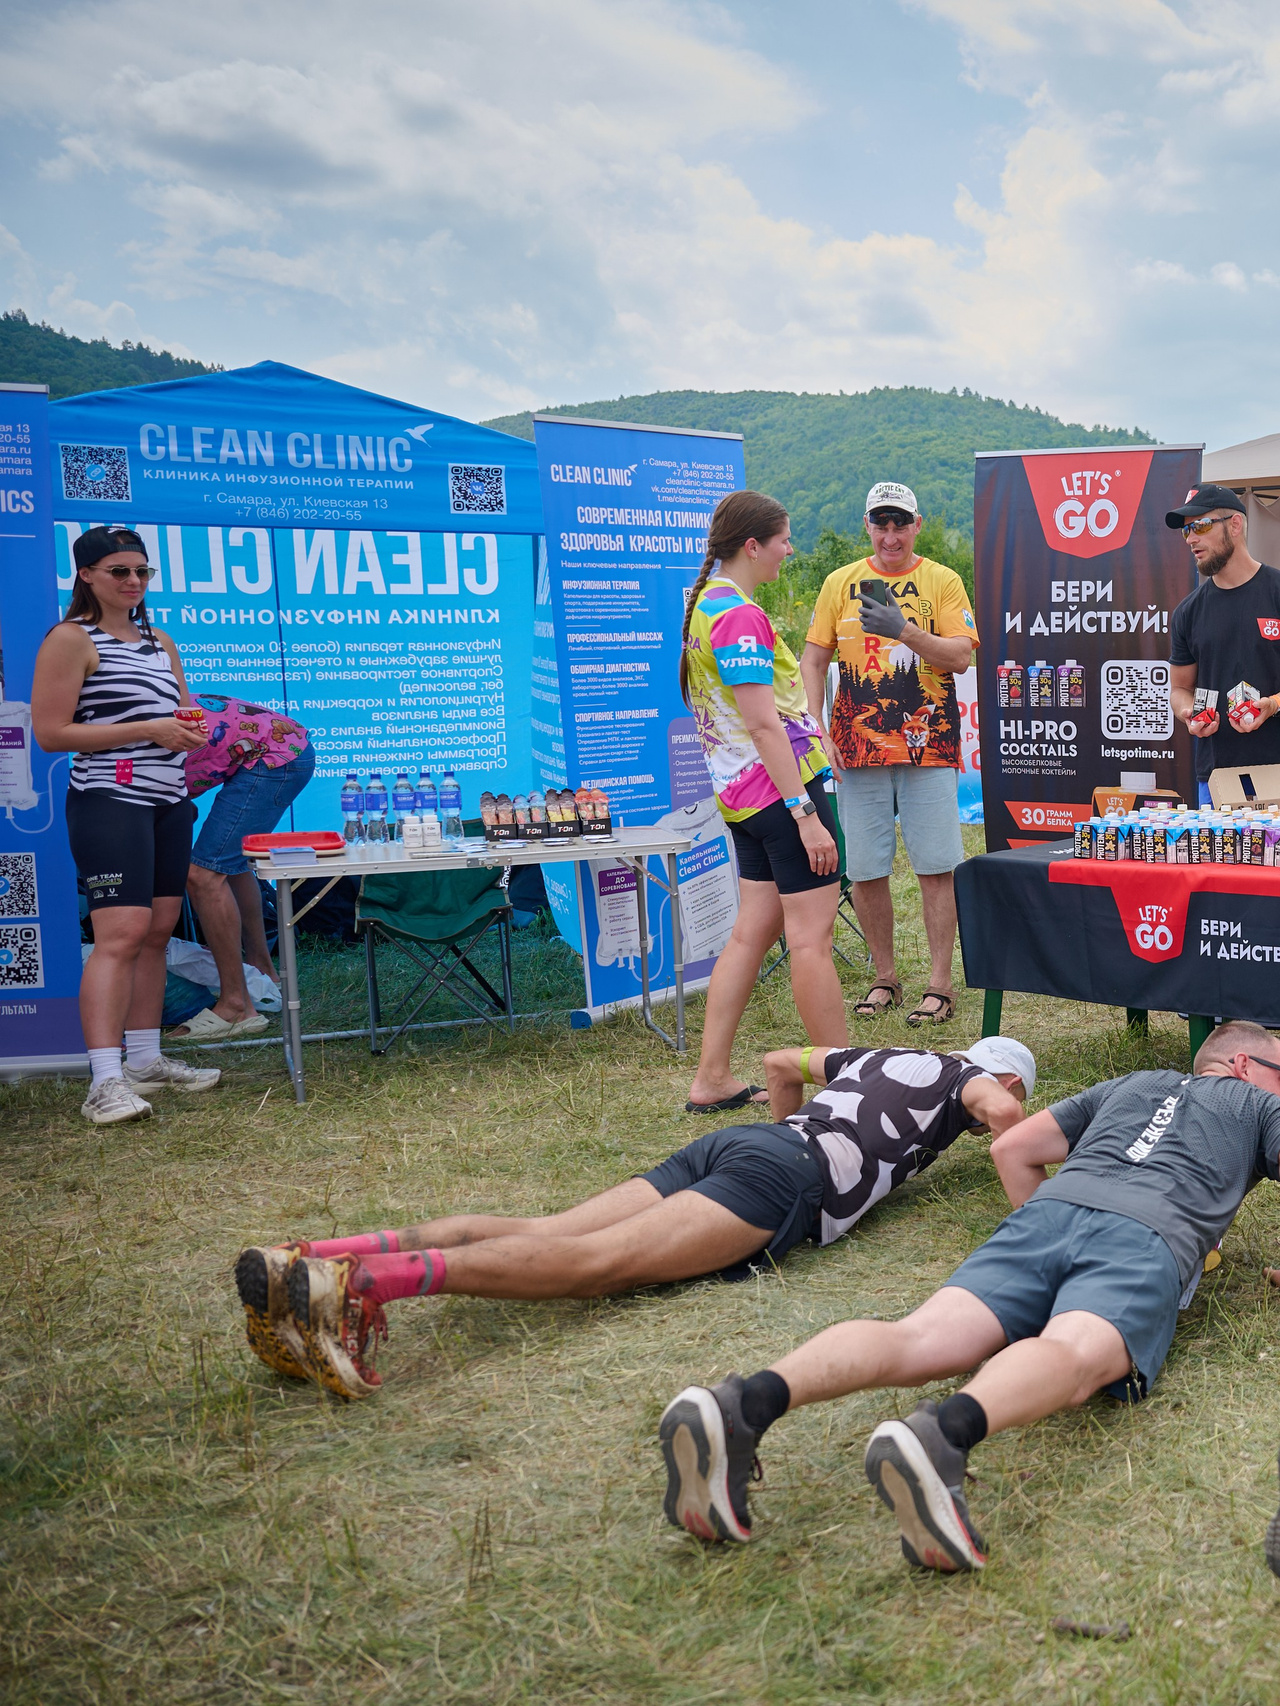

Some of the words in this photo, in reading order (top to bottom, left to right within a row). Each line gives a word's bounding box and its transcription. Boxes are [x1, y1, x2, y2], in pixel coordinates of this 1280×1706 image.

[139, 423, 275, 467] CLEAN
[286, 431, 413, 473] CLINIC
[550, 463, 592, 484] CLEAN
[593, 467, 632, 487] CLINIC
[691, 461, 724, 471] Киевская
[726, 464, 734, 472] 13
[143, 469, 221, 482] КЛИНИКА
[225, 473, 343, 488] ИНФУЗИОННОЙ
[347, 478, 414, 490] ТЕРАПИИ
[1061, 470, 1112, 496] LET'S
[203, 494, 212, 503] г.
[216, 492, 276, 507] Самара,
[280, 496, 299, 509] ул.
[304, 496, 368, 509] Киевская
[373, 498, 388, 509] 13
[235, 506, 251, 518] +7
[257, 507, 290, 521] (846)
[293, 508, 362, 521] 202-20-55
[577, 506, 662, 527] СОВРЕМЕННАЯ
[1054, 498, 1119, 539] GO
[560, 533, 625, 552] ЗДОРОВЬЯ
[629, 536, 682, 553] КРАСОТЫ
[685, 538, 693, 553] И
[561, 560, 581, 568] Наши
[562, 580, 611, 590] ИНФУЗИОННАЯ
[612, 580, 640, 590] ТЕРАПИЯ
[1051, 580, 1113, 603] БЕРИ
[1005, 611, 1022, 634] И
[1029, 604, 1169, 637] ДЕЙСТВУЙ!
[567, 631, 637, 643] ПРОФЕССИОНАЛЬНЫЙ
[637, 632, 663, 642] МАССАЖ
[1263, 626, 1280, 637] GO
[737, 635, 757, 653] Я
[570, 664, 605, 675] ОБШИРНАЯ
[605, 662, 651, 674] ДИАГНОСТИКА
[720, 656, 774, 669] УЛЬТРА
[575, 711, 615, 723] СПОРТИВНОЕ
[615, 708, 659, 720] НАПРАВЛЕНИЕ
[999, 720, 1078, 741] HI-PRO
[999, 742, 1078, 758] COCKTAILS
[1101, 744, 1175, 761] letsgotime.ru
[1001, 758, 1062, 767] ВЫСОКОБЕЛКОВЫЕ
[1001, 767, 1039, 775] МОЛОЧНЫЕ
[1041, 766, 1077, 776] КОКТЕЙЛИ
[1021, 807, 1045, 826] 30
[1046, 809, 1073, 818] ГРАММ
[1046, 817, 1073, 827] БЕЛКА
[679, 861, 702, 878] Clean
[703, 851, 726, 868] Clinic
[615, 877, 626, 885] ДО
[1138, 905, 1168, 923] LET'S
[1134, 922, 1174, 951] GO
[1201, 918, 1242, 938] БЕРИ
[1200, 940, 1211, 957] И
[0, 1004, 37, 1016] ЛЬТАТЫ
